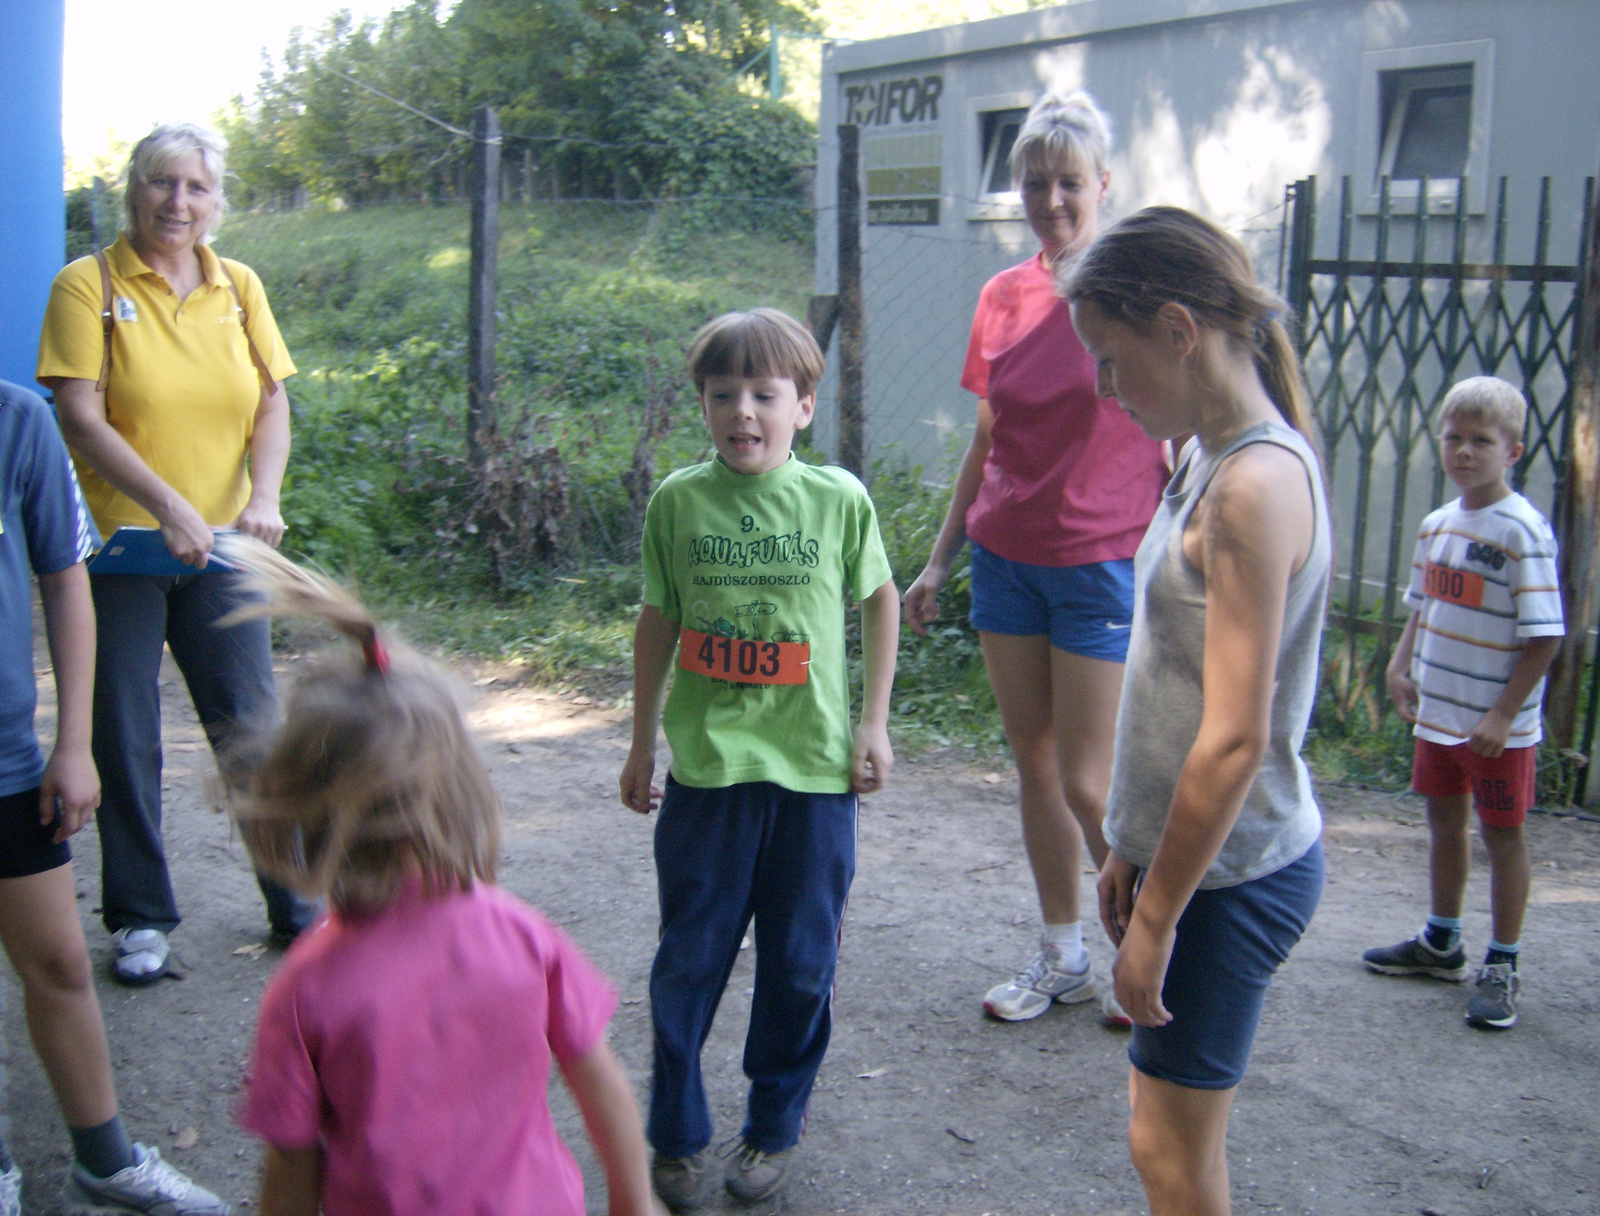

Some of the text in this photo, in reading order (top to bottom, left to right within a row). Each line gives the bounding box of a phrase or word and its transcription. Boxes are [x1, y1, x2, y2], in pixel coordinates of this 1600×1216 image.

[740, 514, 760, 533] 9.
[687, 530, 820, 568] AQUAFUTÁS
[692, 572, 811, 586] HAJDÚSZOBOSZLÓ
[698, 636, 780, 676] 4103
